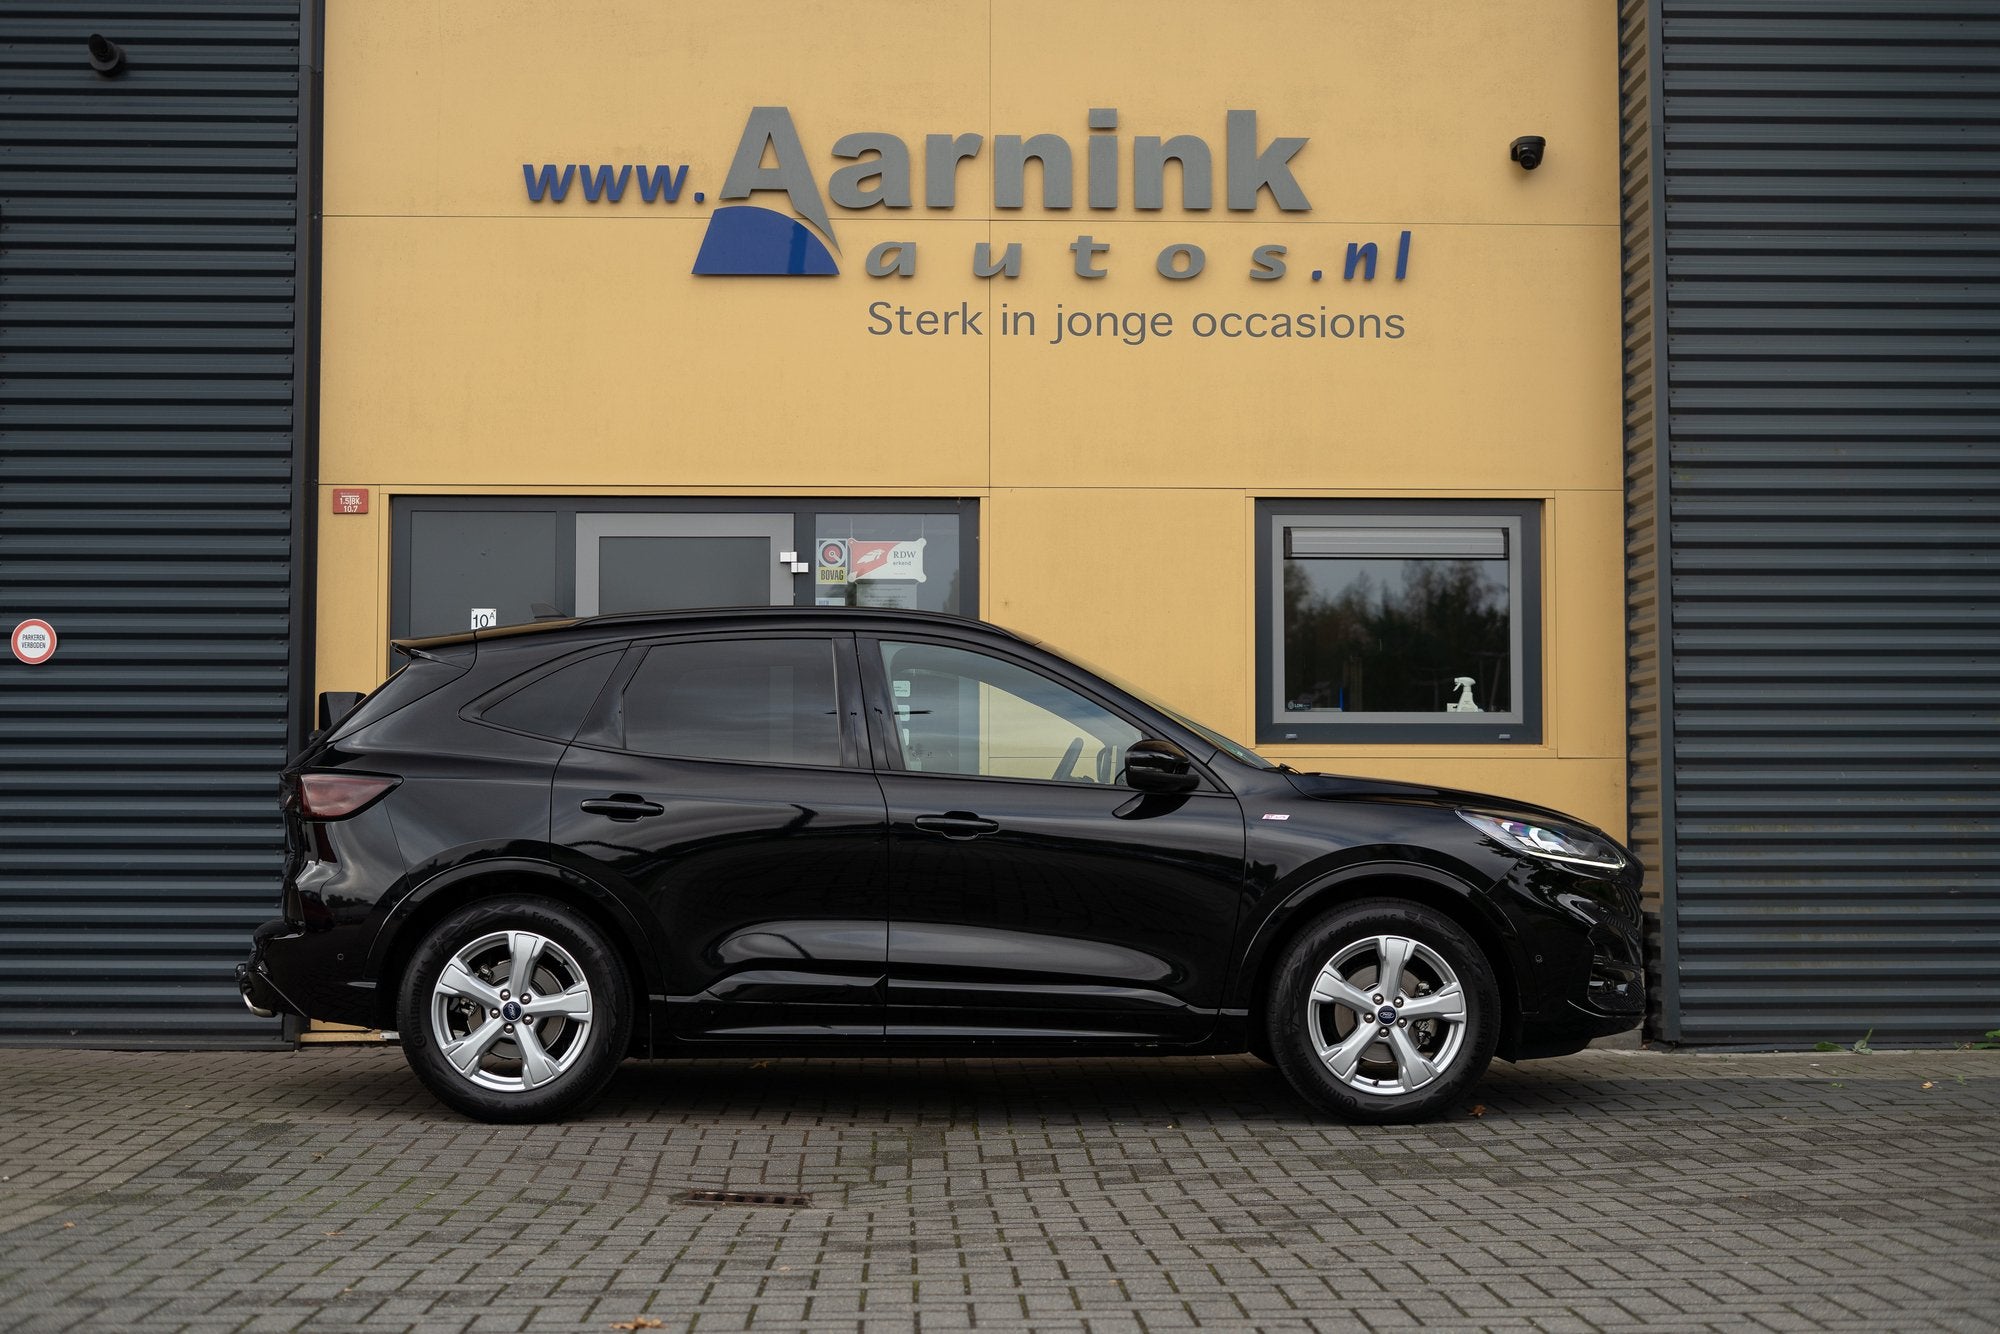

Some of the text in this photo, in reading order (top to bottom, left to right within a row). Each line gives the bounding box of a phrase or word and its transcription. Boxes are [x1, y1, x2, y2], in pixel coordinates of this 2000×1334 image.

[868, 302, 1406, 345] Sterk in jonge occasions
[344, 505, 358, 513] 10.7
[893, 551, 917, 559] RDW
[820, 569, 844, 581] BOVAG
